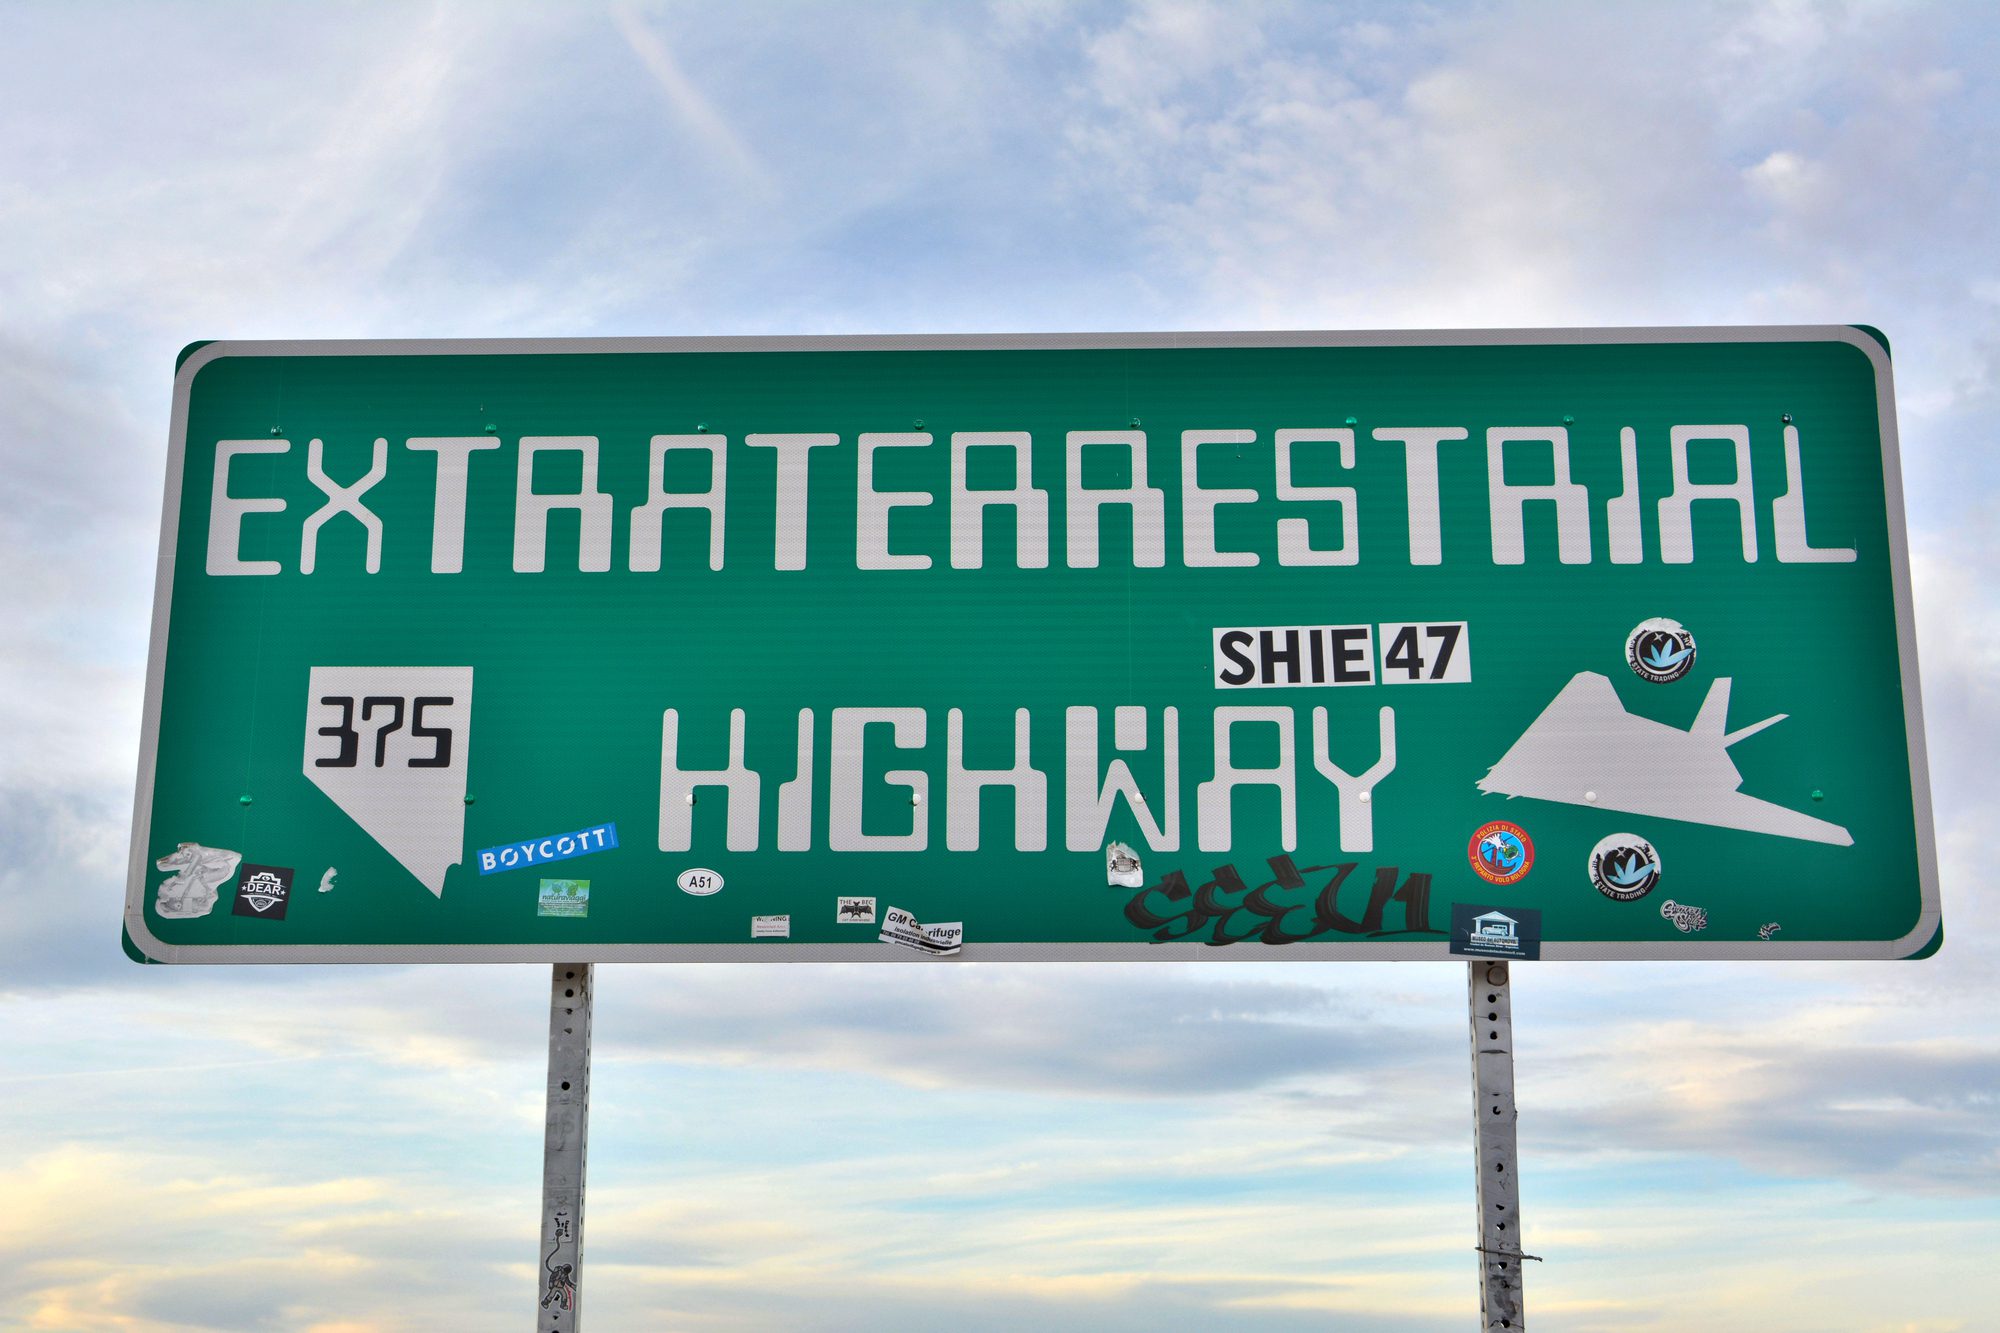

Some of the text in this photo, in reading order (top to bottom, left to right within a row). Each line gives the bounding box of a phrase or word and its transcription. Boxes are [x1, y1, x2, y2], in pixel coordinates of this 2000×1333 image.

[205, 424, 1858, 577] EXTRATERRESTRIAL
[1219, 625, 1462, 686] SHIE 47
[1631, 661, 1650, 679] STATE
[1650, 671, 1680, 682] TRADING
[315, 696, 455, 769] 375
[657, 705, 1396, 853] HIGHWAY
[1476, 824, 1500, 840] POLIZIA
[1510, 827, 1527, 842] STATO
[481, 828, 605, 871] BOYCOTT
[1510, 861, 1530, 881] BOLOGNA
[247, 882, 281, 896] DEAR
[689, 876, 712, 889] A51
[1596, 881, 1646, 900] STATE TRADING
[888, 912, 907, 924] GM
